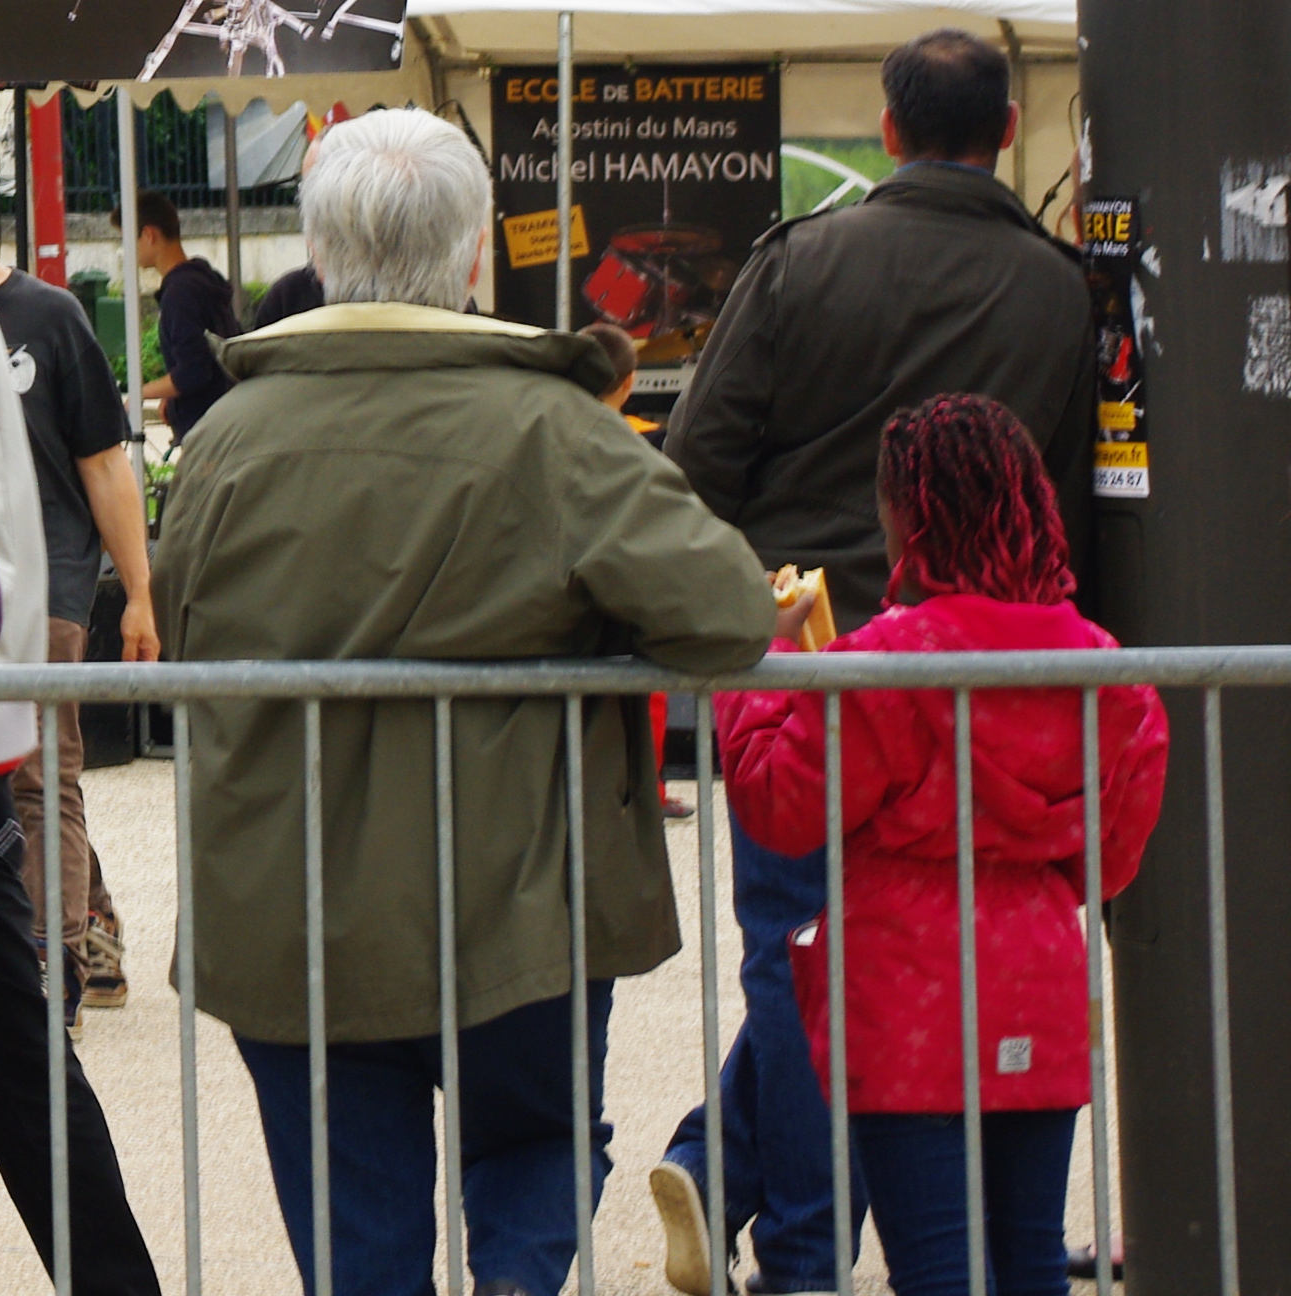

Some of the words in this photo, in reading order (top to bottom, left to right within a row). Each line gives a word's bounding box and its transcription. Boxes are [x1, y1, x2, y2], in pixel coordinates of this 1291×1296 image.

[603, 85, 629, 102] DE
[635, 77, 764, 101] BATTERIE
[637, 116, 665, 138] du
[673, 117, 737, 138] Mans
[604, 152, 773, 182] HAMAYON
[1084, 212, 1132, 241] ERIE
